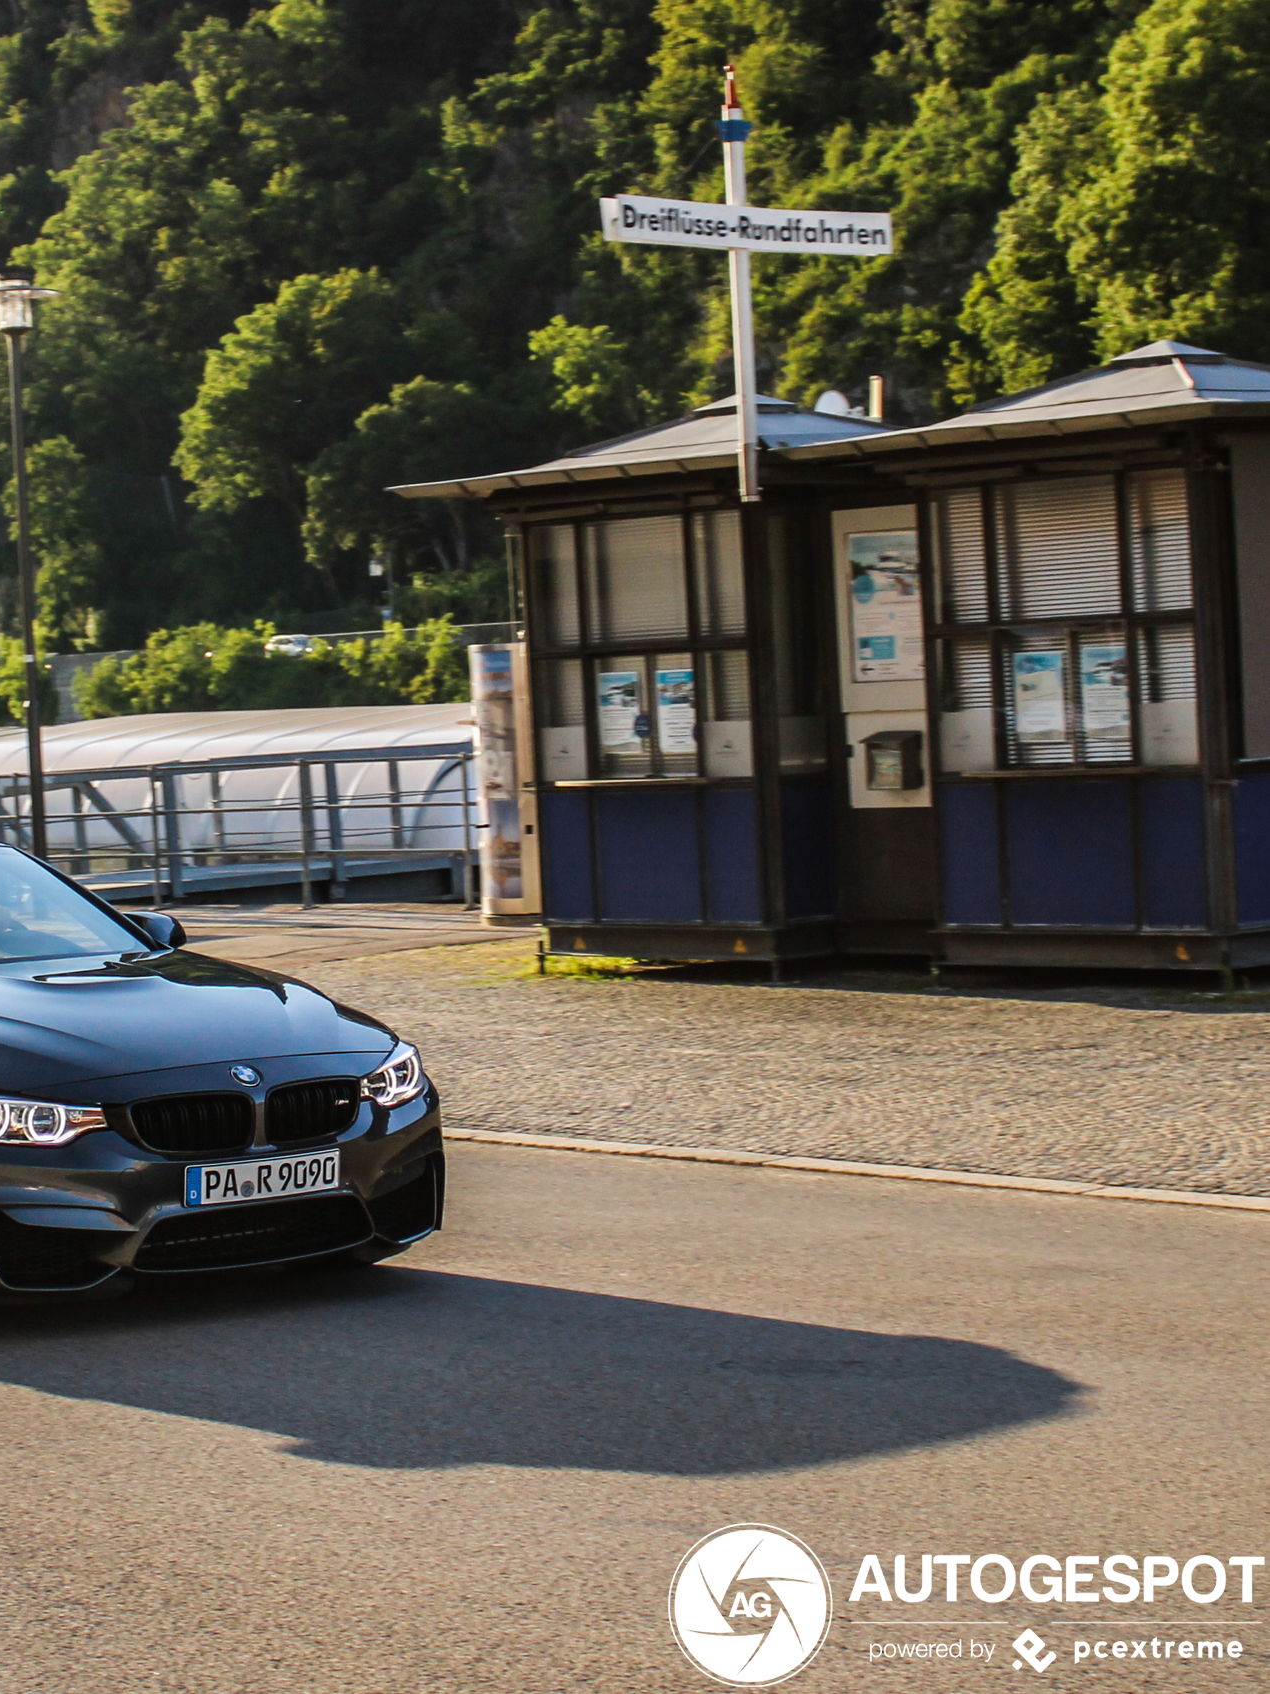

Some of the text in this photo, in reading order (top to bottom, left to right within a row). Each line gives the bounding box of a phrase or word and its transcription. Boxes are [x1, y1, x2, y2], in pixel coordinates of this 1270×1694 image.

[622, 203, 887, 245] Dreiflüsse-Rundfahrten
[190, 1190, 198, 1199] D
[204, 1156, 336, 1200] PA R 9090
